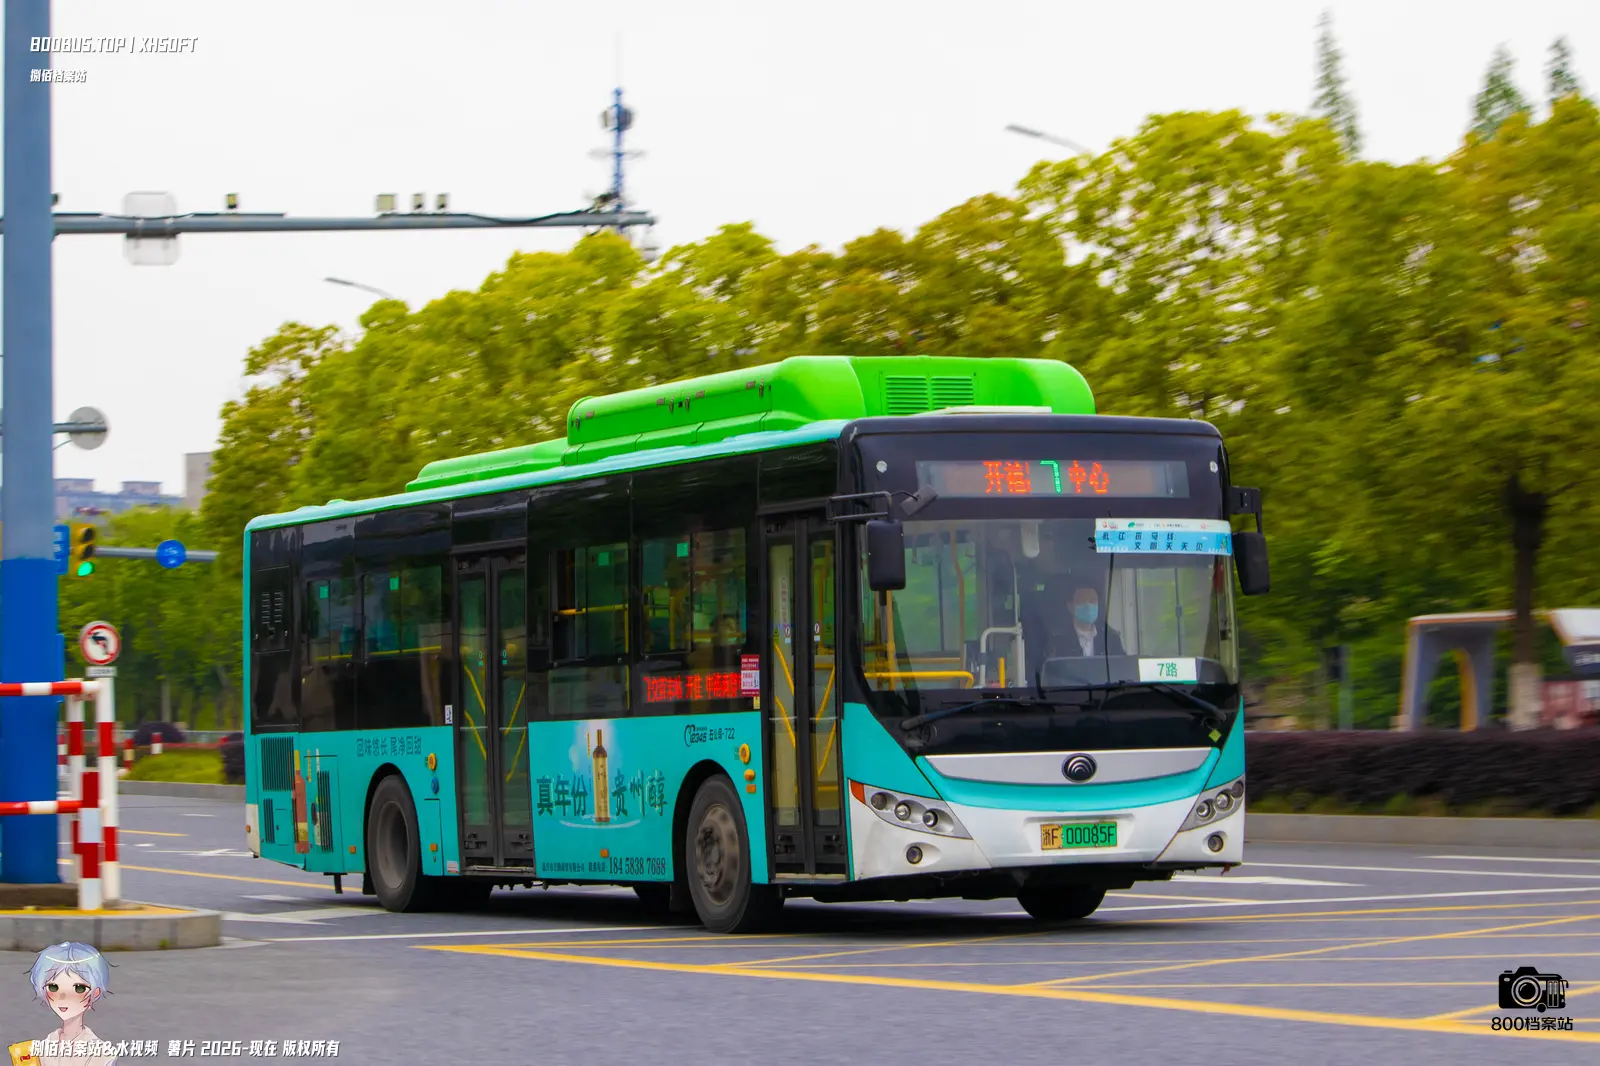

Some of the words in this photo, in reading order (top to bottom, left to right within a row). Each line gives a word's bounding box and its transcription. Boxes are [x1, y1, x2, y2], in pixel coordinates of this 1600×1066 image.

[1040, 460, 1061, 494] 7
[1068, 460, 1109, 494] 中心
[1157, 662, 1178, 678] 7路
[536, 772, 588, 816] 真年份
[612, 769, 668, 817] 贵州醇
[1065, 825, 1115, 845] 00085F
[609, 857, 623, 875] 184
[625, 857, 645, 875] 5838
